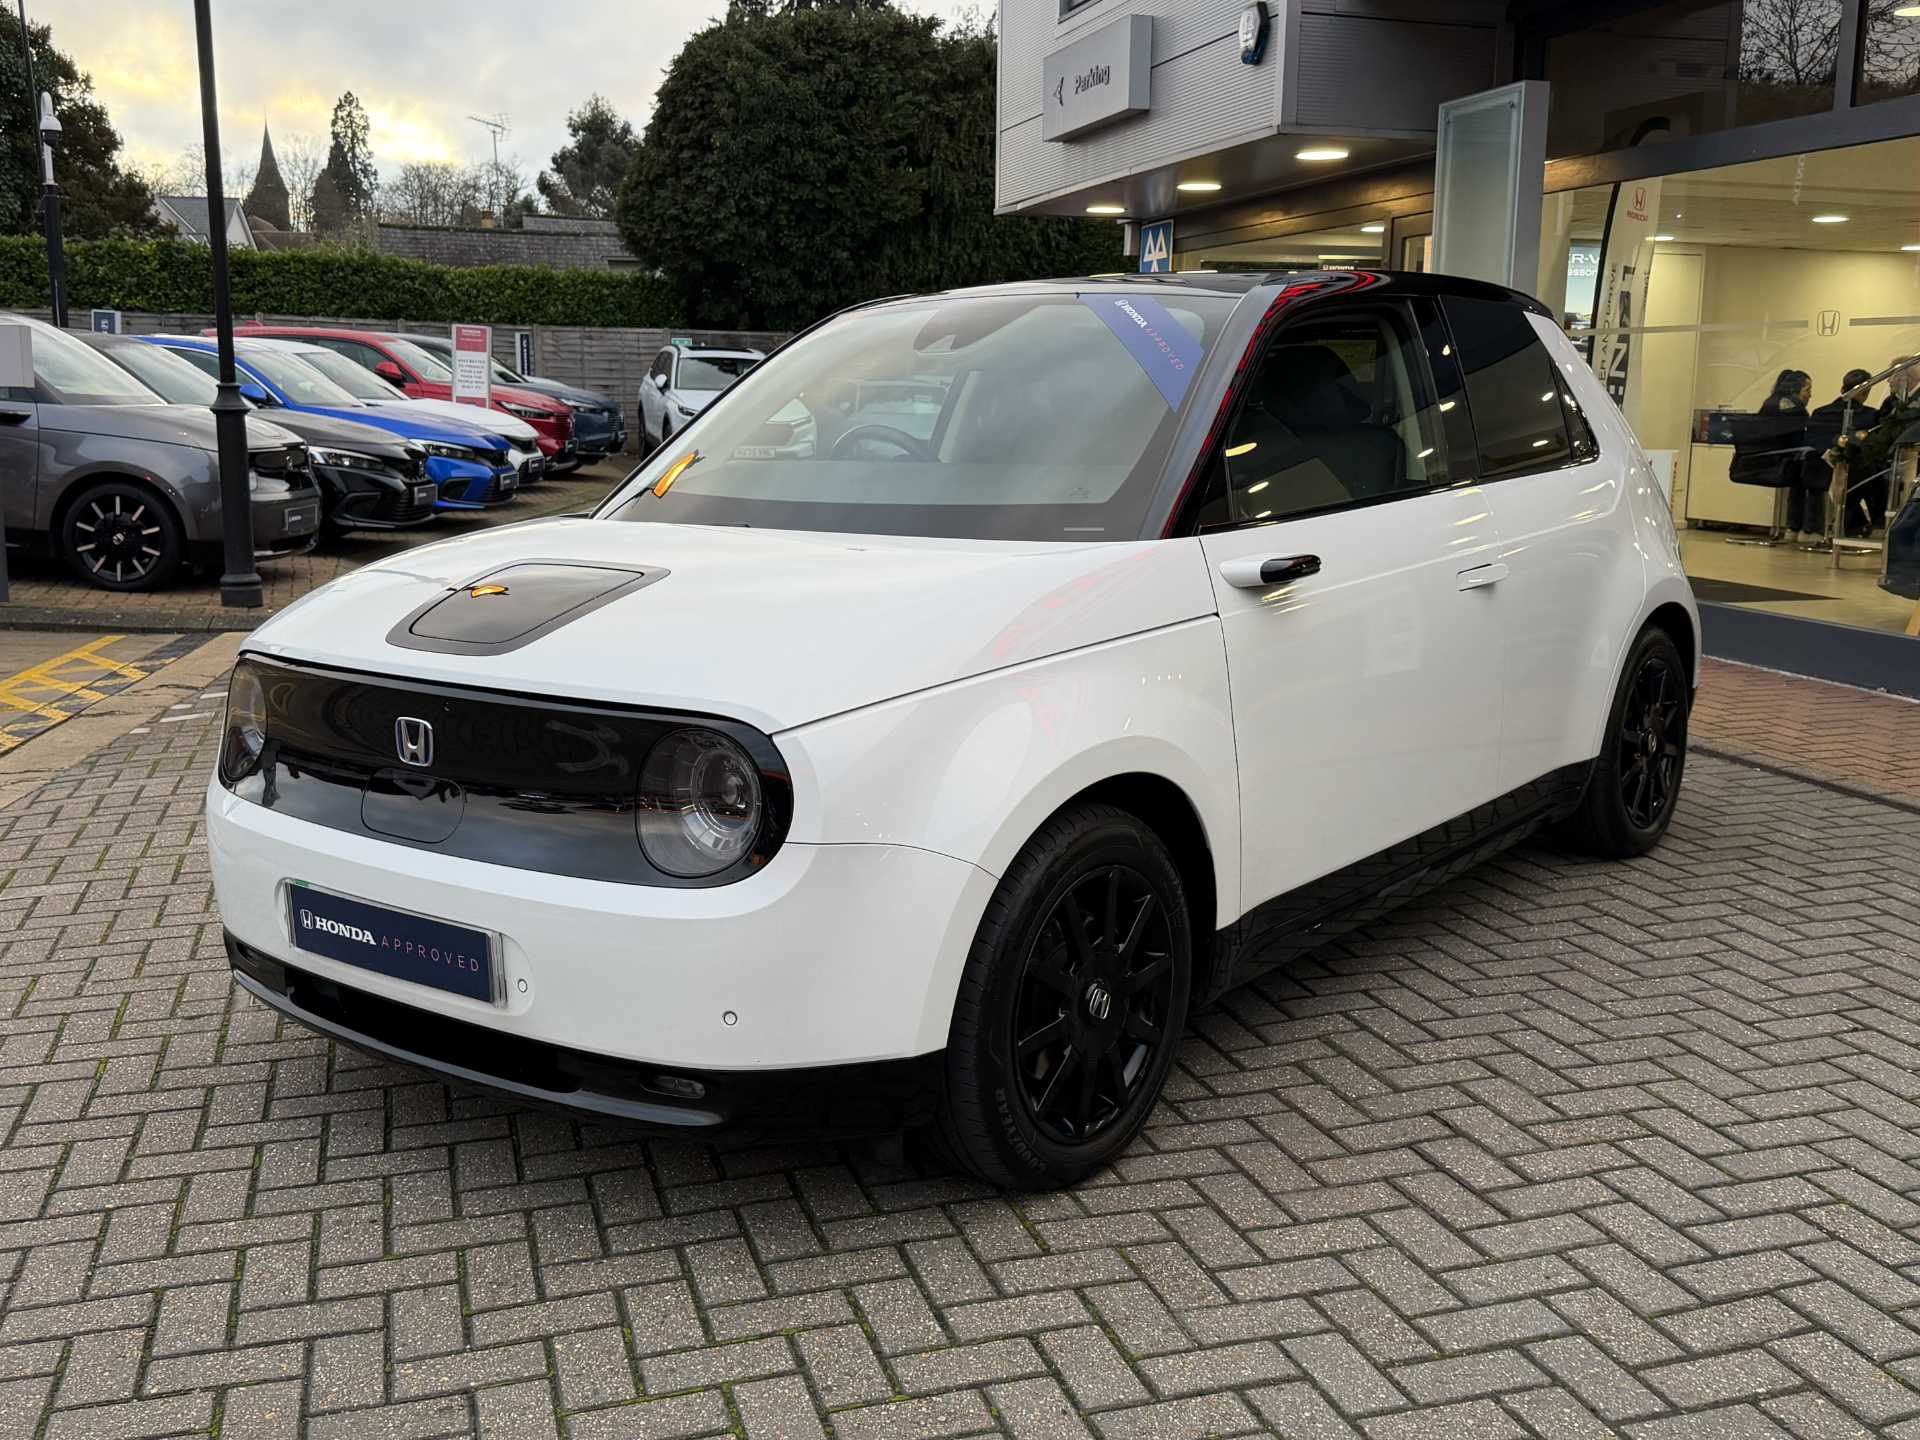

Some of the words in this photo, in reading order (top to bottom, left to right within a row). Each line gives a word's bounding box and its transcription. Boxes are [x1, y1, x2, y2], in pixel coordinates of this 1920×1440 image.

[1075, 65, 1110, 95] Parking
[1568, 253, 1600, 265] R-V
[1121, 303, 1148, 328] HONDA
[1145, 328, 1184, 370] APPROVED
[314, 915, 377, 946] HONDA
[381, 935, 480, 972] APPROVED
